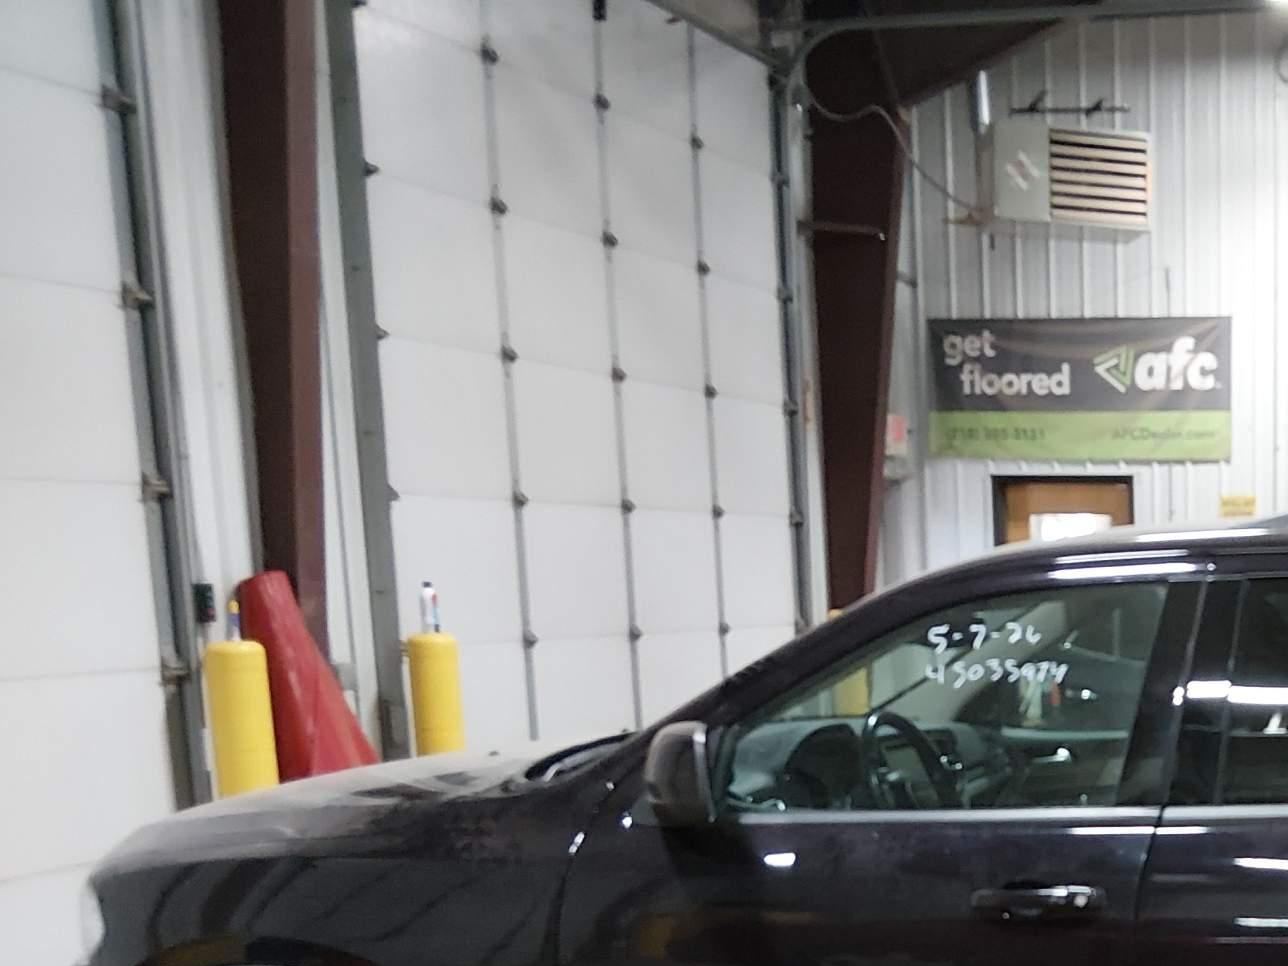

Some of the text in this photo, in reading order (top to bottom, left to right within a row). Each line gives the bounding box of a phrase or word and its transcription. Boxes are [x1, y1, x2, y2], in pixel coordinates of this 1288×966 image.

[943, 329, 996, 366] get
[1134, 336, 1219, 391] afc
[960, 362, 1071, 396] floored
